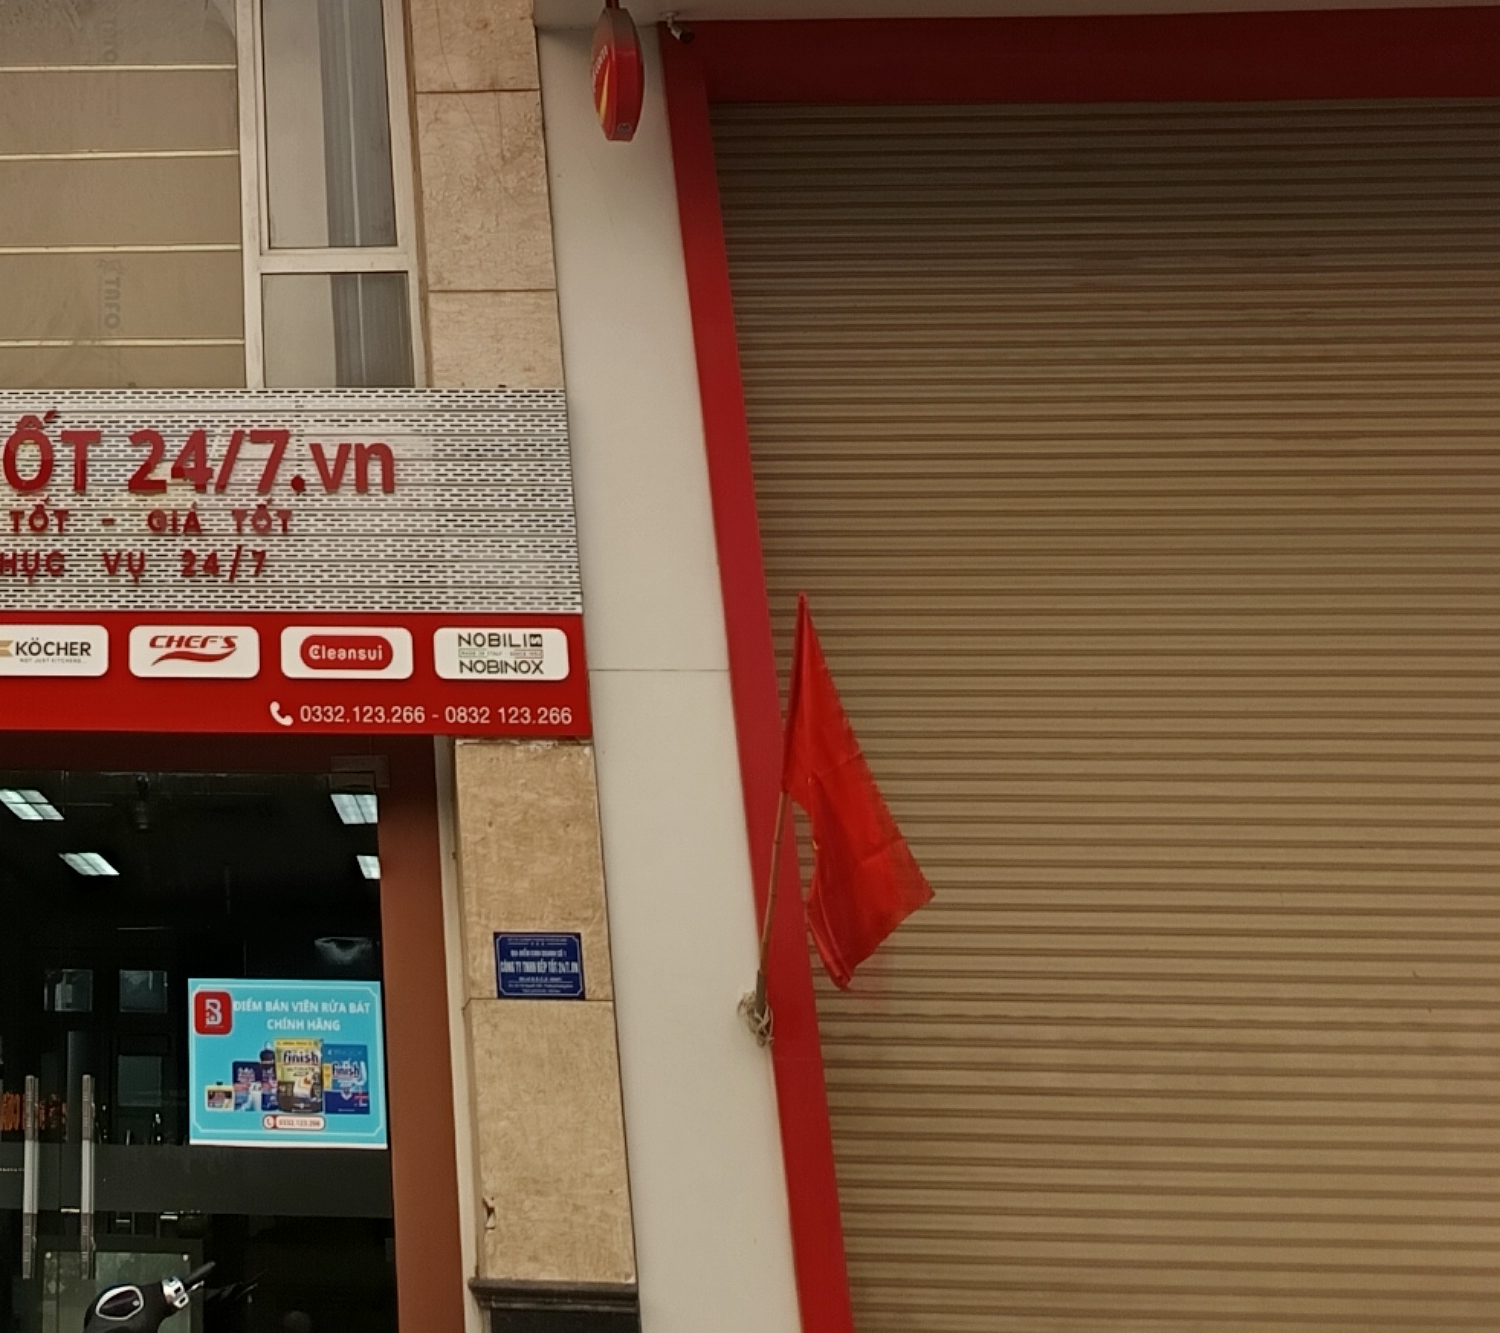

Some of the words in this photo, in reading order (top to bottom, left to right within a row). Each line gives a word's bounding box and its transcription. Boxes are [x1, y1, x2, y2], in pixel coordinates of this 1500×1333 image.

[128, 428, 396, 496] 24/7.vn
[8, 495, 70, 534] TỐT
[147, 501, 203, 535] GIÁ
[230, 497, 293, 535] TỐT
[101, 550, 146, 586] VỤ
[180, 545, 268, 583] 24/7
[15, 636, 92, 657] KÖCHER
[148, 634, 239, 650] CHEF'S
[308, 644, 383, 661] Cleansui
[459, 660, 545, 675] NOBINOX
[300, 705, 426, 724] 0332.123.266
[445, 706, 491, 724] 0832
[498, 706, 573, 725] 123.266
[265, 998, 289, 1012] BÁN
[266, 1017, 305, 1031] CHÍNH
[283, 1049, 319, 1065] finish
[332, 1063, 360, 1078] finish
